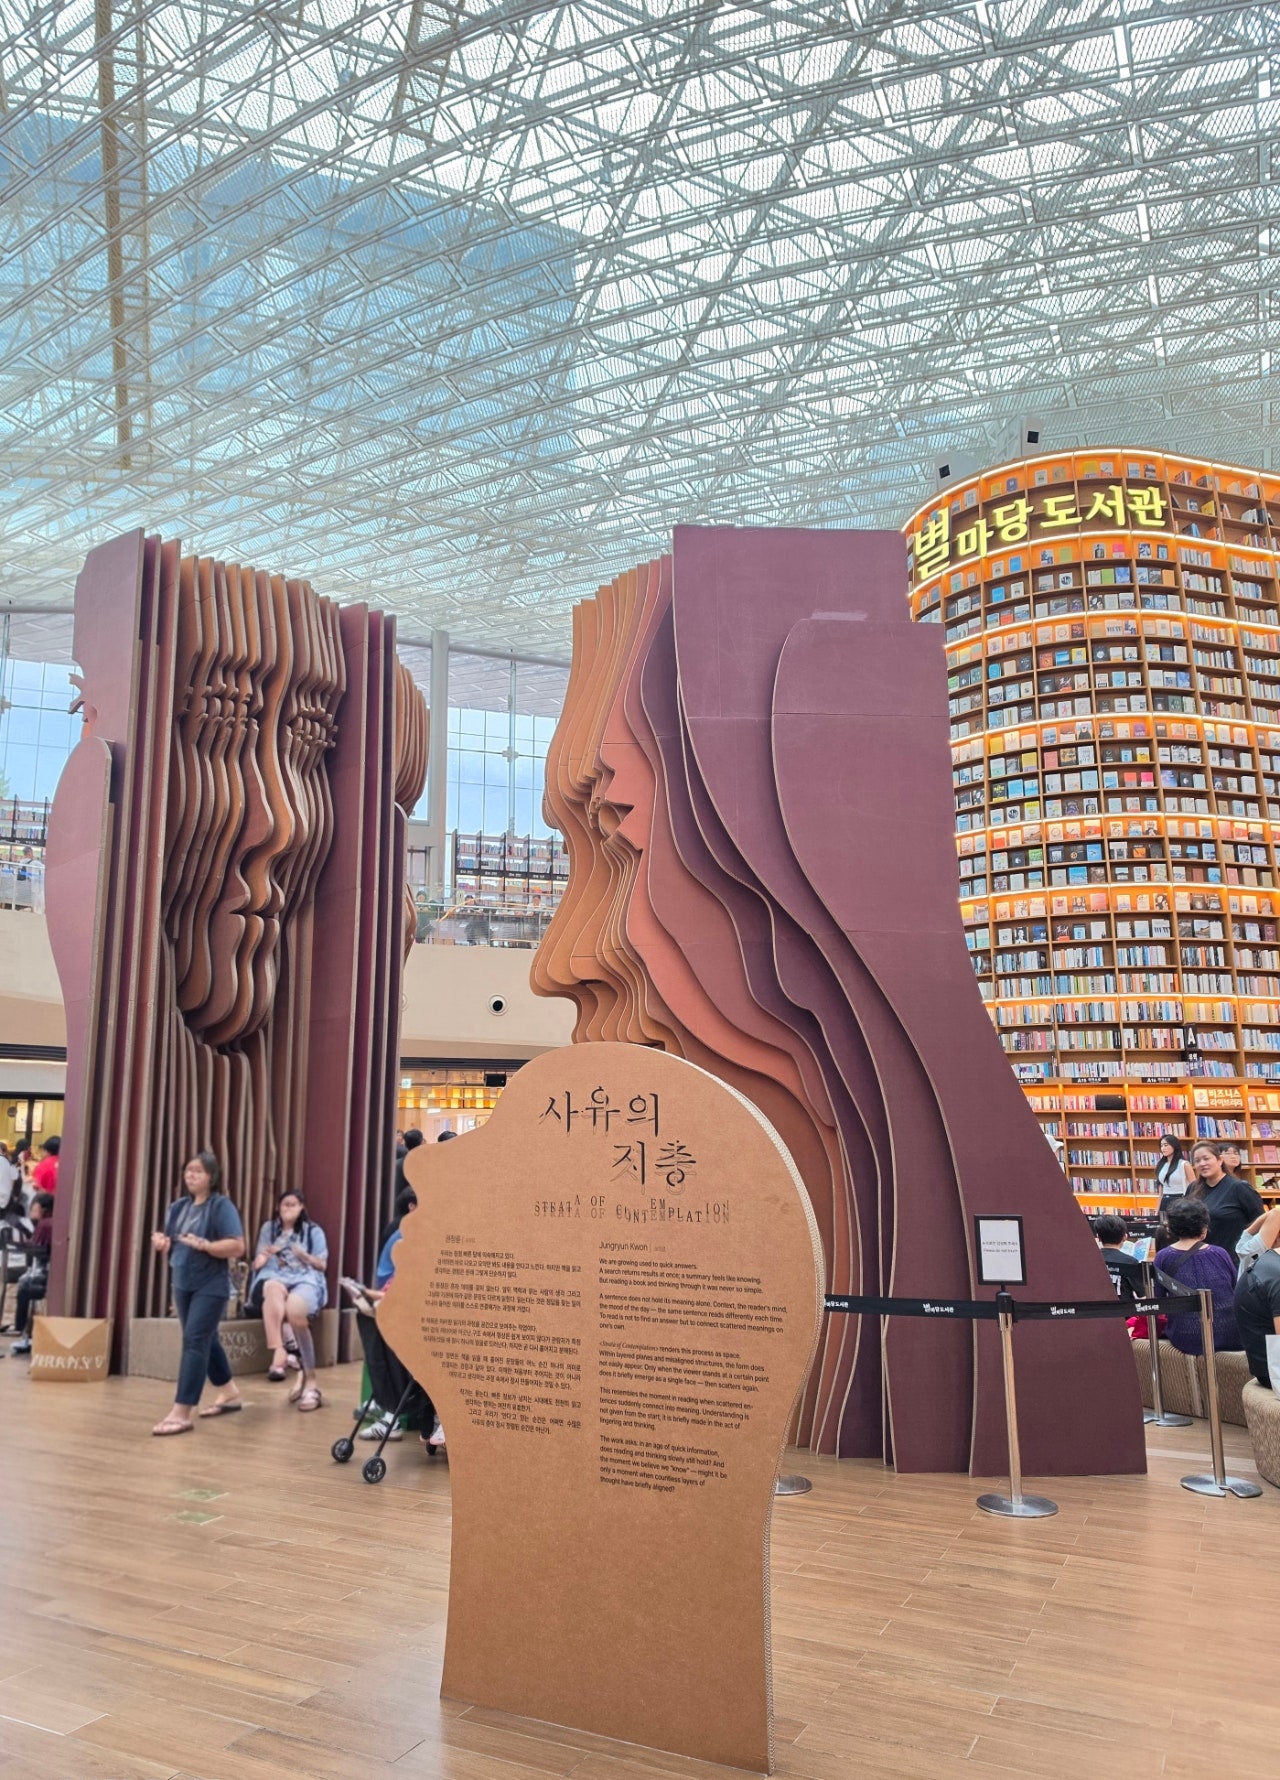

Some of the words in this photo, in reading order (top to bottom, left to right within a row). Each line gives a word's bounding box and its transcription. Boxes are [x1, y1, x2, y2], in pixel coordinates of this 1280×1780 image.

[914, 499, 1033, 580] 별마당
[1040, 484, 1167, 529] 도서관
[1187, 1027, 1196, 1045] A
[1208, 1088, 1241, 1098] 비즈니스
[539, 1086, 660, 1137] 사유의
[611, 1140, 697, 1189] 지층
[534, 1195, 580, 1218] STRATA
[590, 1196, 606, 1218] OF
[616, 1198, 730, 1223] CONTEMPLATION
[599, 1241, 629, 1251] Jungryun
[630, 1242, 648, 1251] Kwon
[599, 1256, 607, 1264] We
[617, 1258, 638, 1267] growing
[659, 1260, 673, 1269] quick
[604, 1266, 621, 1274] search
[622, 1267, 640, 1275] returns
[686, 1273, 710, 1281] summary
[712, 1273, 725, 1281] feels
[604, 1292, 627, 1300] sentence
[651, 1295, 663, 1303] hold
[671, 1297, 694, 1307] meaning
[737, 1301, 746, 1309] the
[598, 1348, 615, 1357] Within
[616, 1350, 634, 1360] layered
[635, 1352, 652, 1362] planes
[654, 1353, 664, 1361] and
[665, 1354, 694, 1366] misaligned
[725, 1360, 734, 1368] the
[735, 1361, 749, 1369] form
[750, 1362, 764, 1371] does
[599, 1405, 608, 1413] not
[609, 1406, 623, 1417] given
[624, 1408, 636, 1416] from
[672, 1414, 689, 1424] briefly
[690, 1416, 706, 1424] made
[713, 1418, 723, 1426] the
[724, 1420, 733, 1428] act
[618, 1398, 641, 1409] suddenly
[642, 1400, 664, 1409] connect
[664, 1403, 675, 1411] into
[702, 1407, 743, 1420] Understanding
[599, 1415, 621, 1426] lingering
[622, 1418, 632, 1426] and
[600, 1434, 609, 1442] The
[610, 1435, 623, 1444] work
[671, 1443, 685, 1453] quick
[600, 1444, 612, 1452] does
[613, 1446, 633, 1457] reading
[634, 1449, 644, 1457] and
[645, 1450, 666, 1461] thinking
[668, 1453, 684, 1464] slowly
[686, 1455, 695, 1463] still
[696, 1456, 711, 1465] hold?
[713, 1459, 724, 1467] And
[600, 1454, 608, 1462] the
[609, 1456, 630, 1465] moment
[640, 1460, 659, 1469] believe
[670, 1464, 689, 1473] "know"
[697, 1467, 713, 1478] might
[719, 1470, 727, 1478] be
[599, 1464, 610, 1474] only
[616, 1467, 638, 1476] moment
[639, 1470, 653, 1478] when
[654, 1472, 680, 1482] countless
[681, 1476, 698, 1486] layers
[600, 1475, 620, 1486] thought
[620, 1478, 634, 1486] have
[634, 1479, 651, 1490] briefly
[652, 1482, 675, 1494] aligned?
